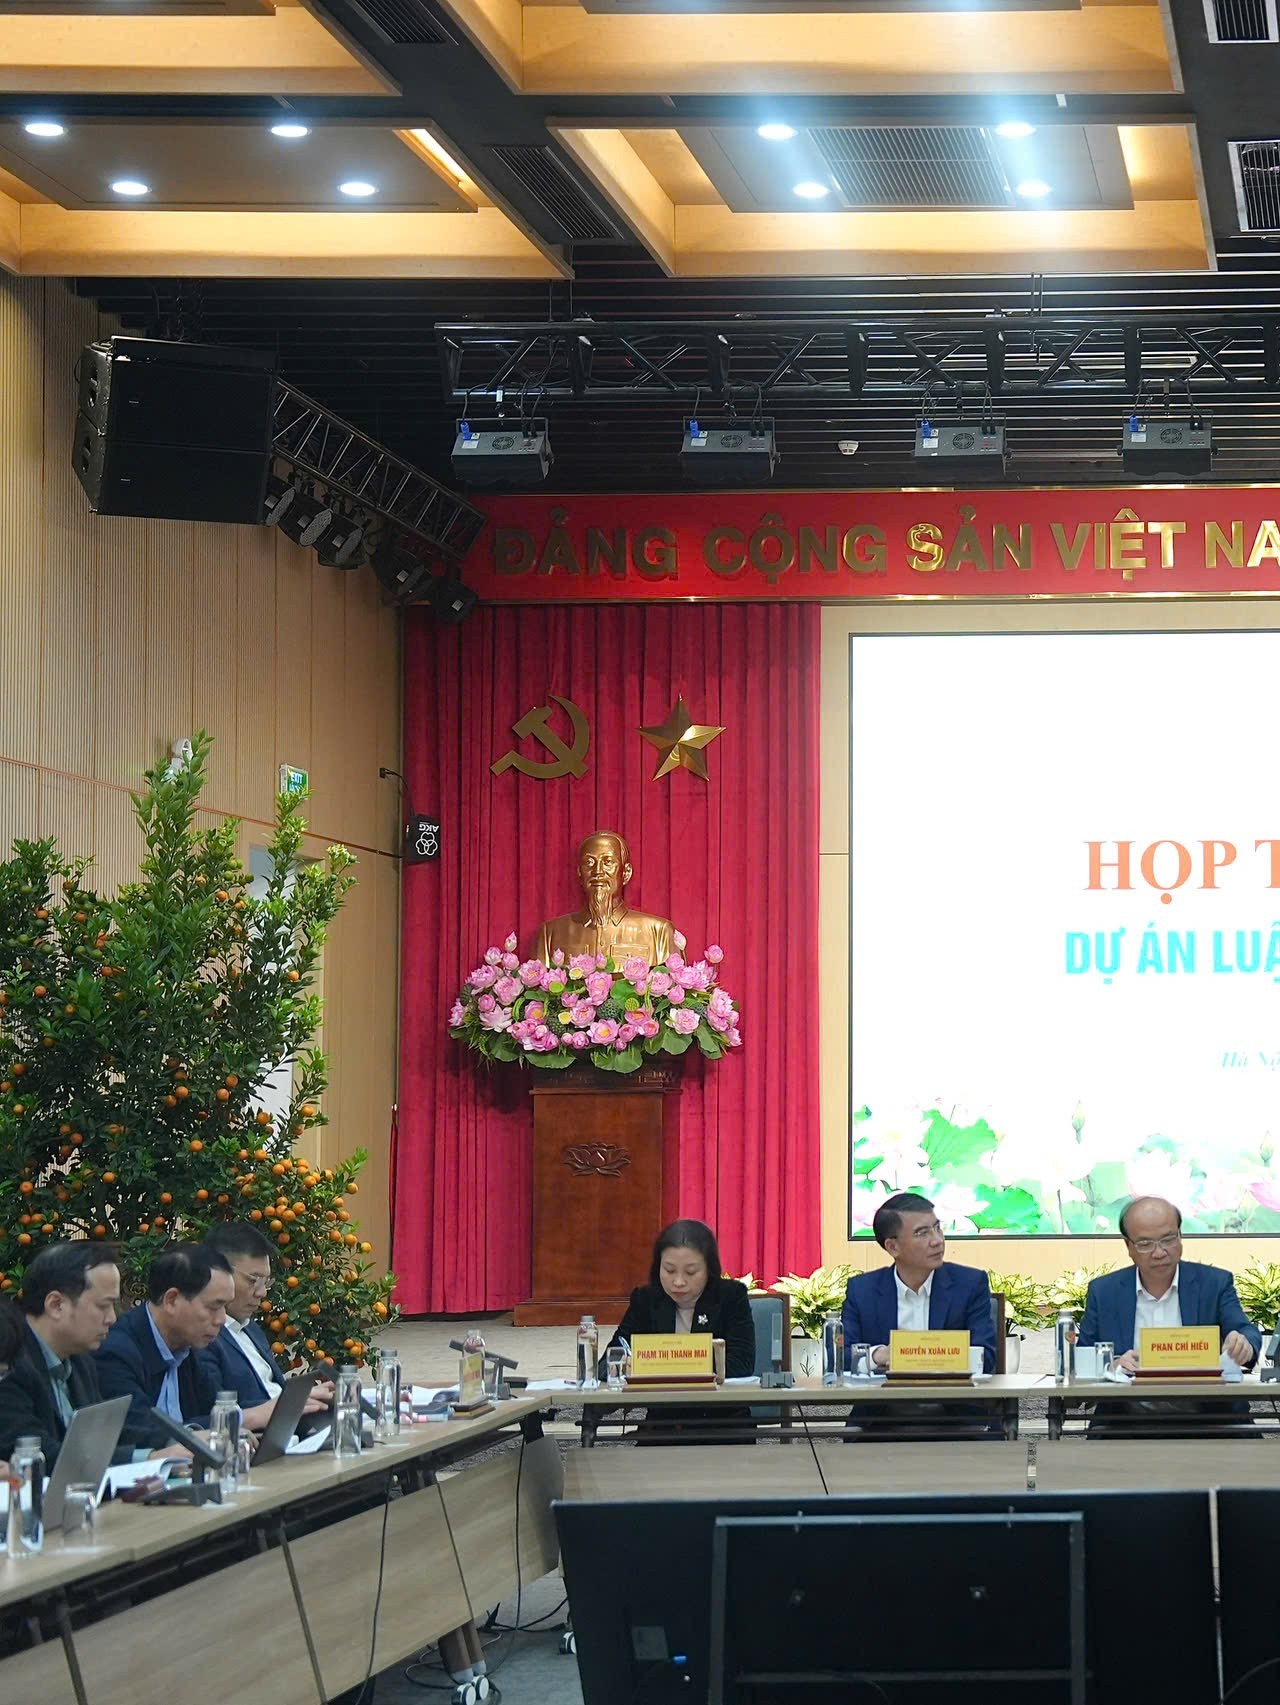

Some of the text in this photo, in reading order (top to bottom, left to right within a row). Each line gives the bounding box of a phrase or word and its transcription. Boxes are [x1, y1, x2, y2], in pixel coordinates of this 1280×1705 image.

[492, 508, 678, 580] ĐẢNG
[703, 511, 888, 584] CỘNG
[906, 505, 1011, 572] SẢN
[1050, 508, 1187, 581] VIỆT
[418, 823, 439, 833] AKG
[1083, 840, 1237, 905] HỌP
[1065, 927, 1126, 985] DỰ
[1136, 921, 1196, 974] ÁN
[671, 1350, 692, 1358] THANH
[694, 1349, 707, 1358] MAI
[1151, 1343, 1173, 1352] PHAN
[1175, 1341, 1189, 1351] CHÍ
